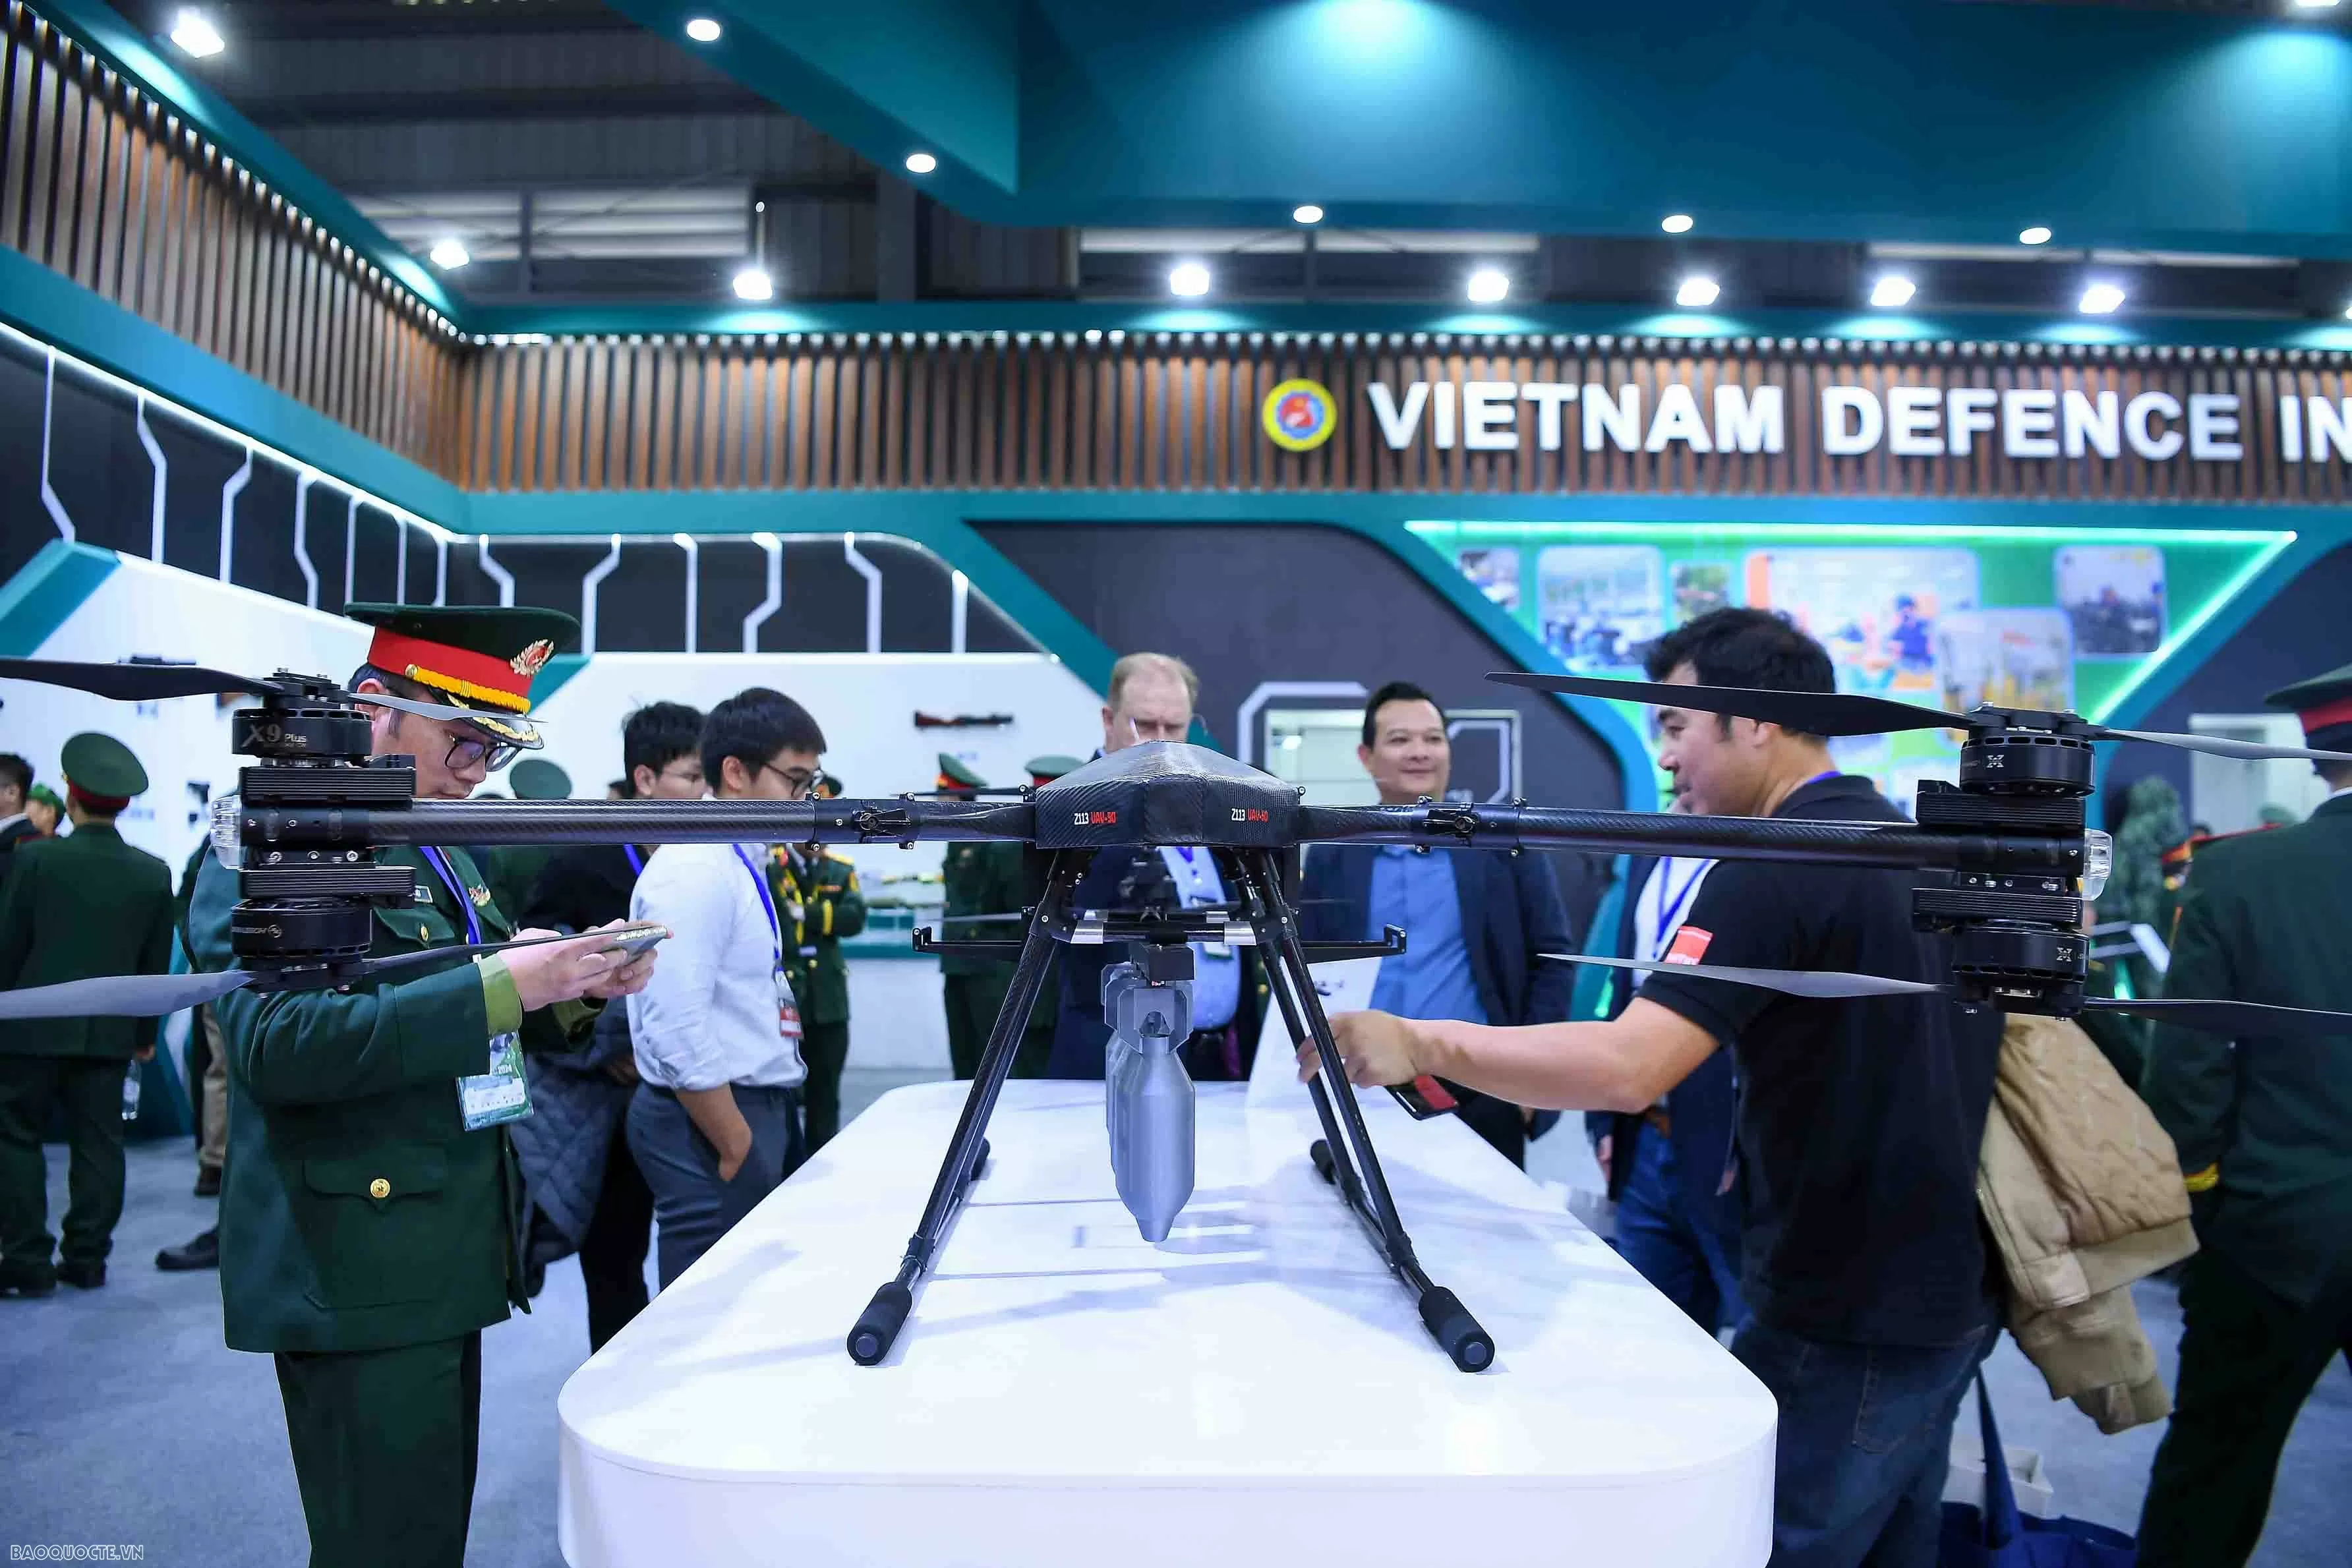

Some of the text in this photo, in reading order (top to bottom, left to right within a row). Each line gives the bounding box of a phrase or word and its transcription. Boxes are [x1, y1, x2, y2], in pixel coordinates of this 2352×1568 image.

[1368, 382, 2352, 463] VIETNAM DEFENCE IN
[241, 723, 307, 747] X9 Plus
[1074, 812, 1089, 825] Z113
[1231, 808, 1245, 821] Z113
